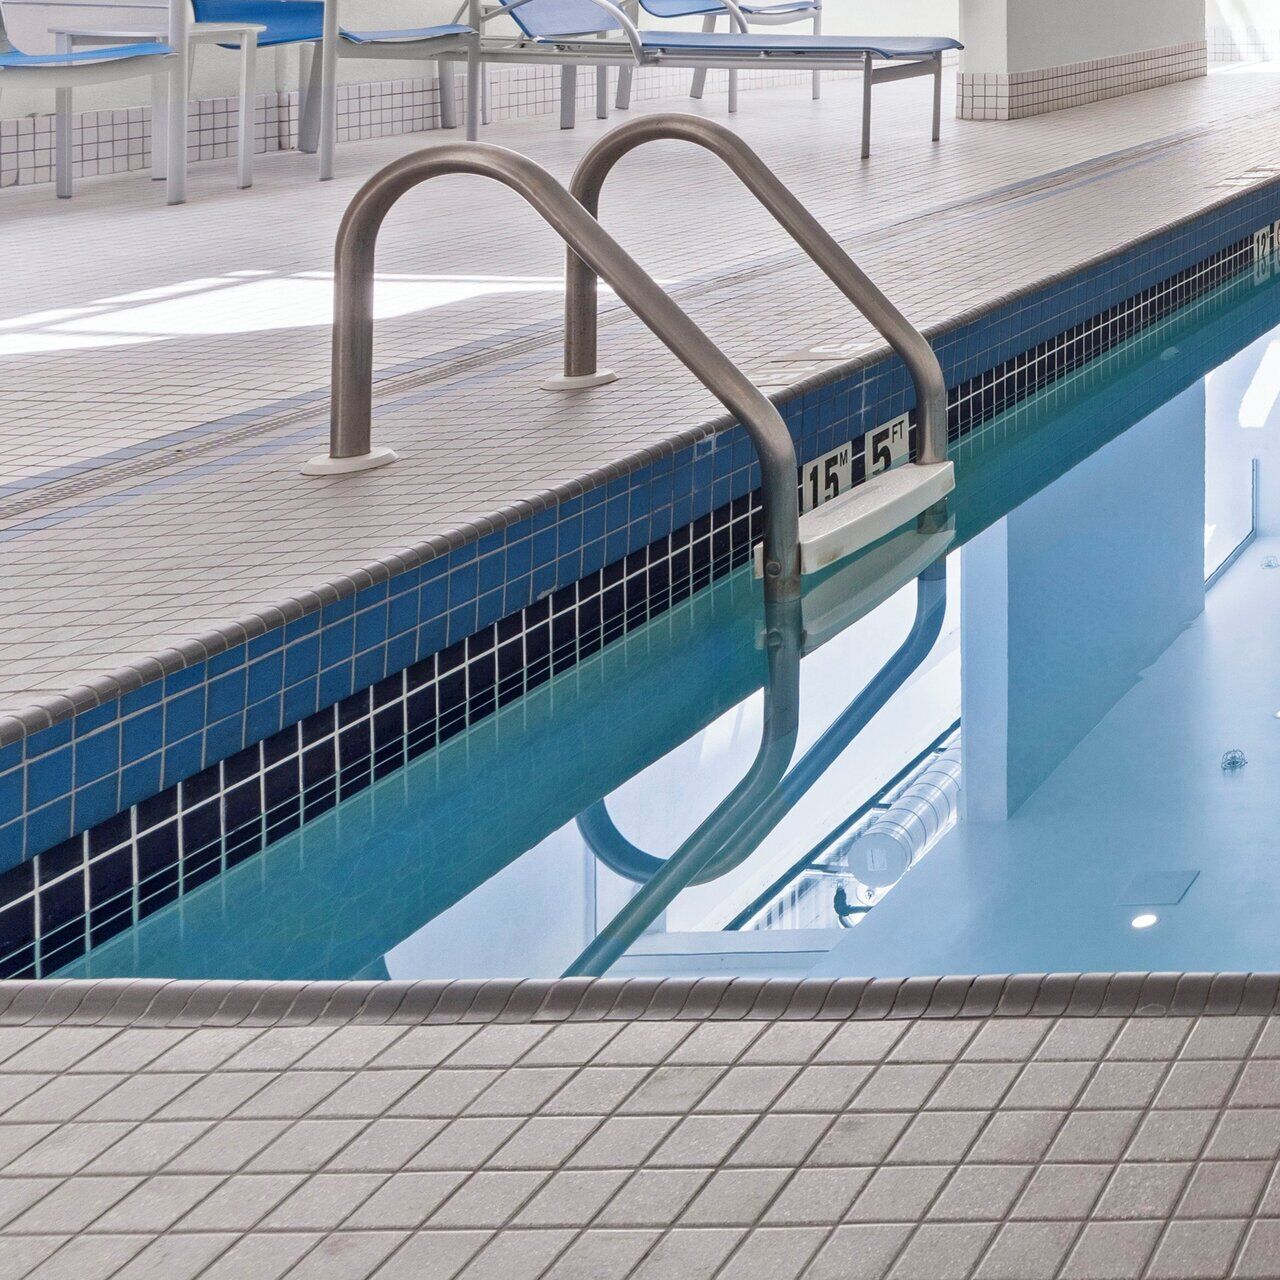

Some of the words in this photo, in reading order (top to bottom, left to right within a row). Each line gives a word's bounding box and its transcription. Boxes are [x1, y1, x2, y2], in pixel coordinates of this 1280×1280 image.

[840, 448, 848, 468] M
[872, 427, 891, 476] 5
[892, 419, 905, 444] FT
